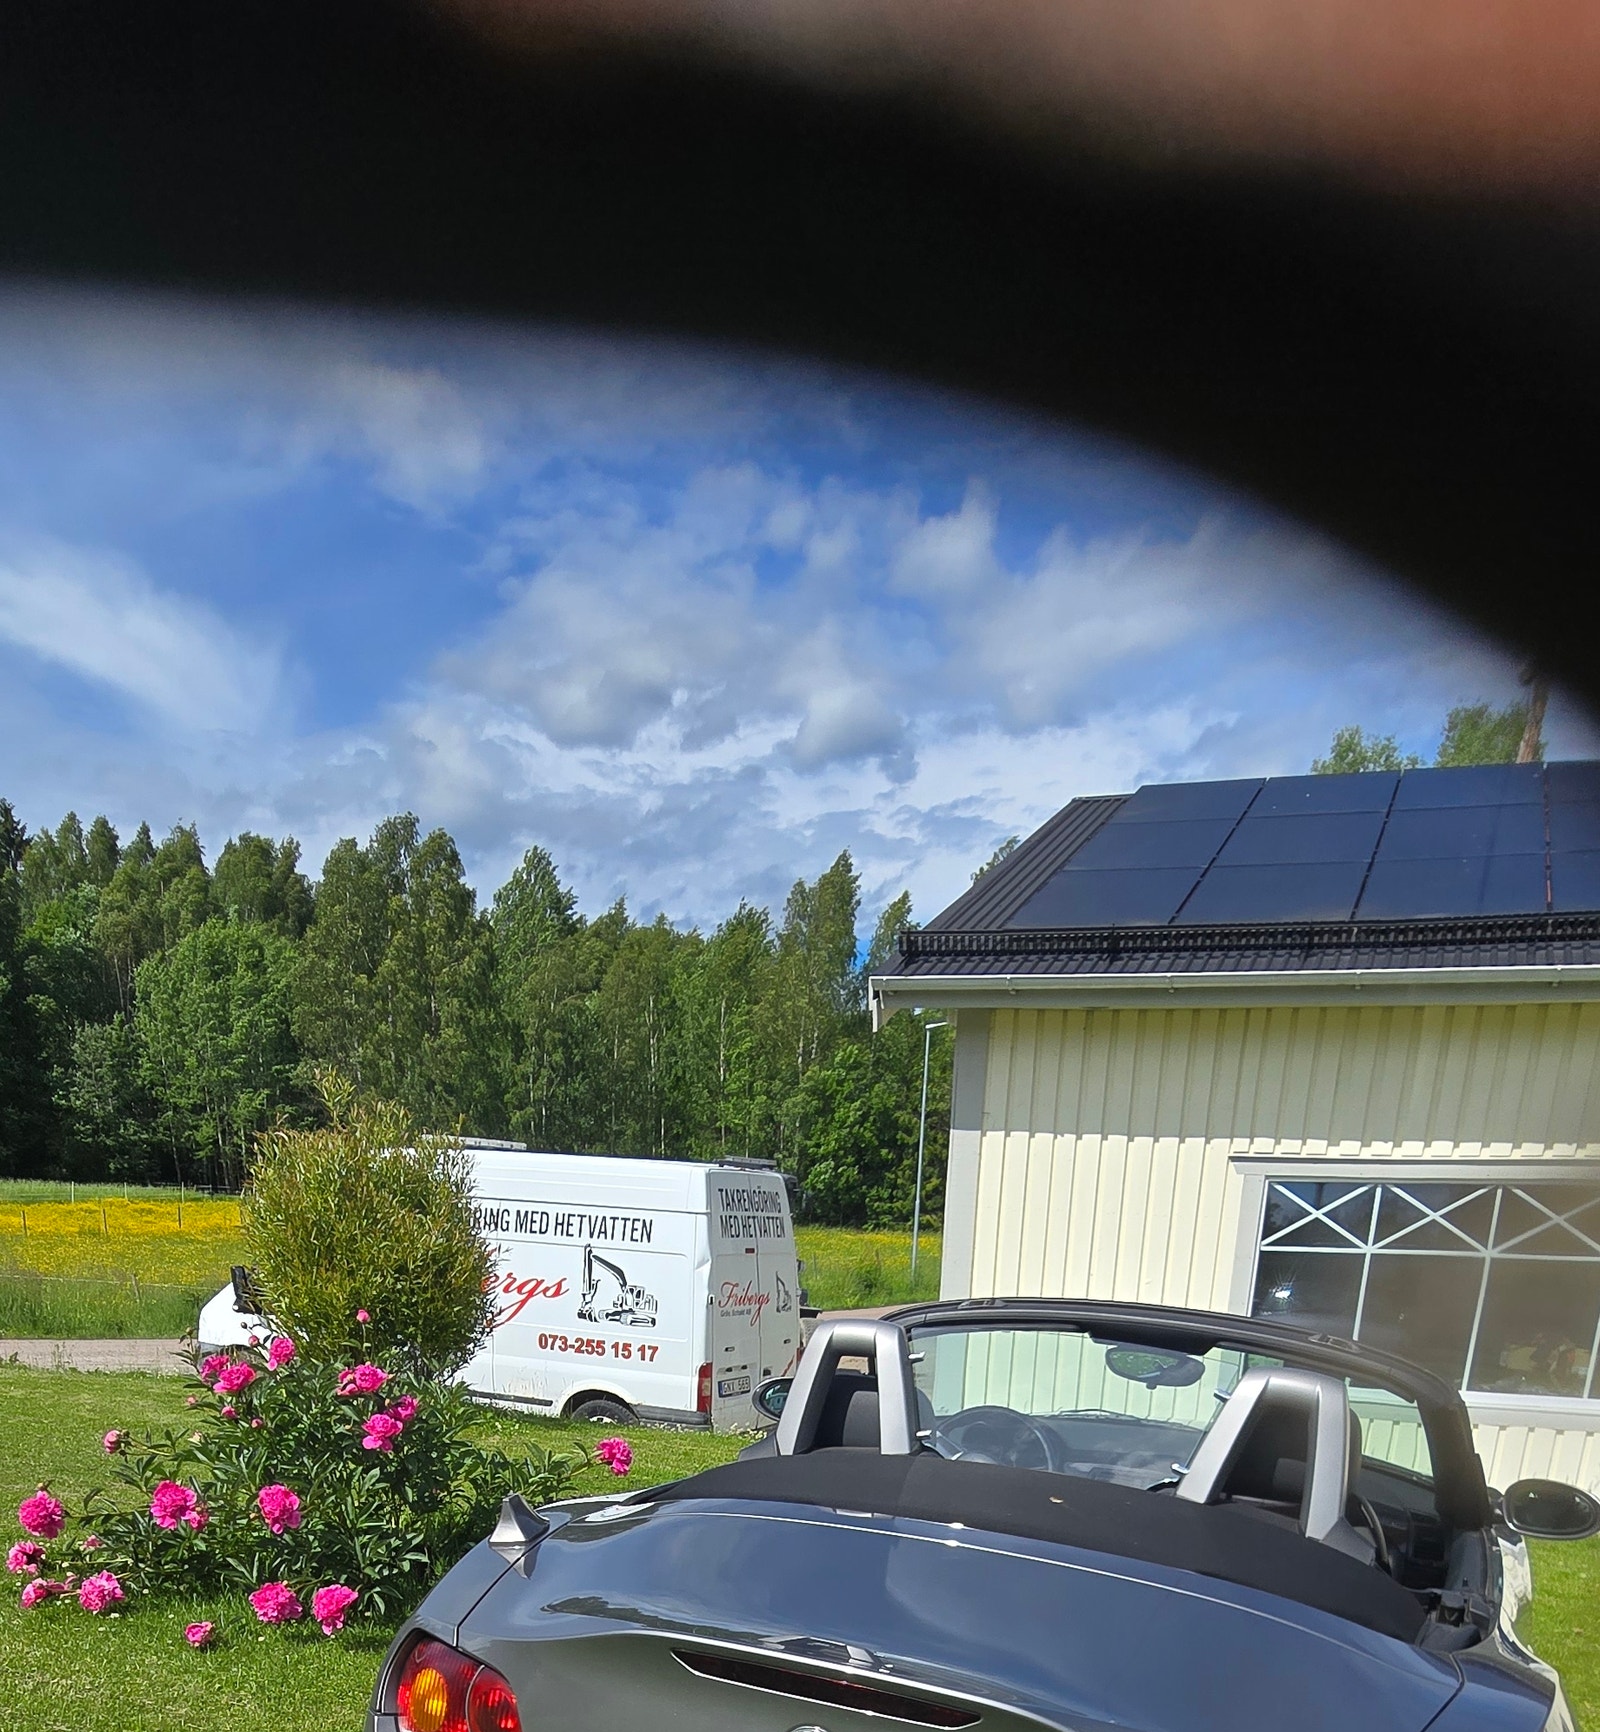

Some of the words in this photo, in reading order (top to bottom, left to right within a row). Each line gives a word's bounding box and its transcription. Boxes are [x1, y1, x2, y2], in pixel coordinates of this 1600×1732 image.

[718, 1185, 781, 1213] TAKRENGÖRING
[514, 1209, 549, 1235] MED
[554, 1212, 653, 1243] HETVATTEN
[720, 1214, 740, 1238] MED
[741, 1215, 785, 1238] HETVATTEN
[718, 1280, 770, 1327] Fribergs
[538, 1333, 606, 1356] 073-255
[611, 1341, 632, 1359] 15
[636, 1344, 659, 1362] 17
